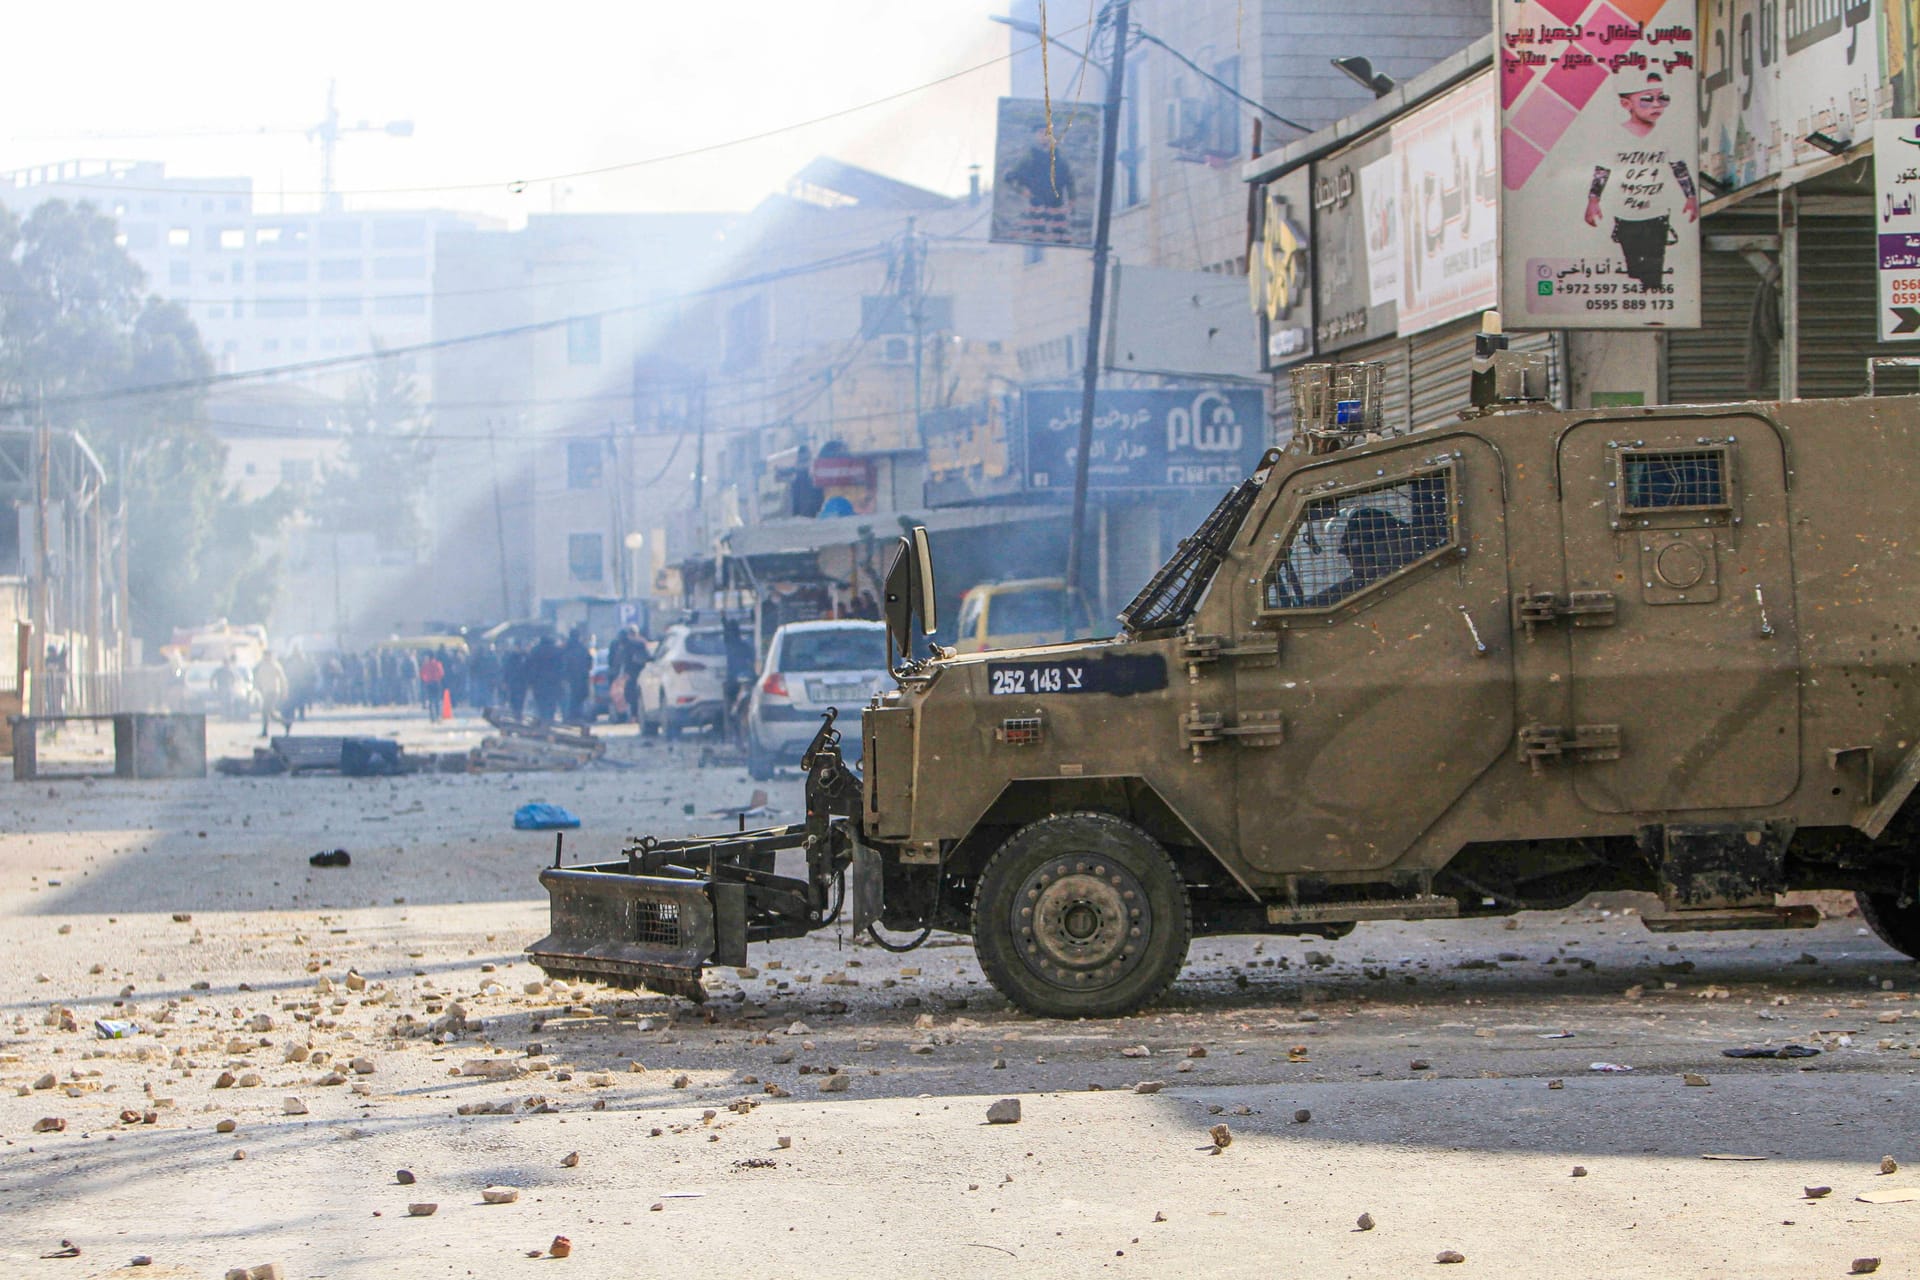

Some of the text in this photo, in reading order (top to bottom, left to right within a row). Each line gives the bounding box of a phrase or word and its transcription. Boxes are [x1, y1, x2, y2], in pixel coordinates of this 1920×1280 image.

[1538, 24, 1582, 46] تجهيز
[1599, 20, 1644, 46] أطفال
[1647, 25, 1692, 45] ملابس
[1625, 168, 1649, 180] OF
[1895, 167, 1920, 184] كتور
[1556, 258, 1592, 282] وأخي
[1595, 258, 1611, 275] أنا
[1557, 284, 1590, 294] +972
[1594, 284, 1617, 294] 597
[1586, 299, 1674, 310] 0595 889 173
[992, 670, 1026, 695] 252
[1030, 668, 1062, 692] 143
